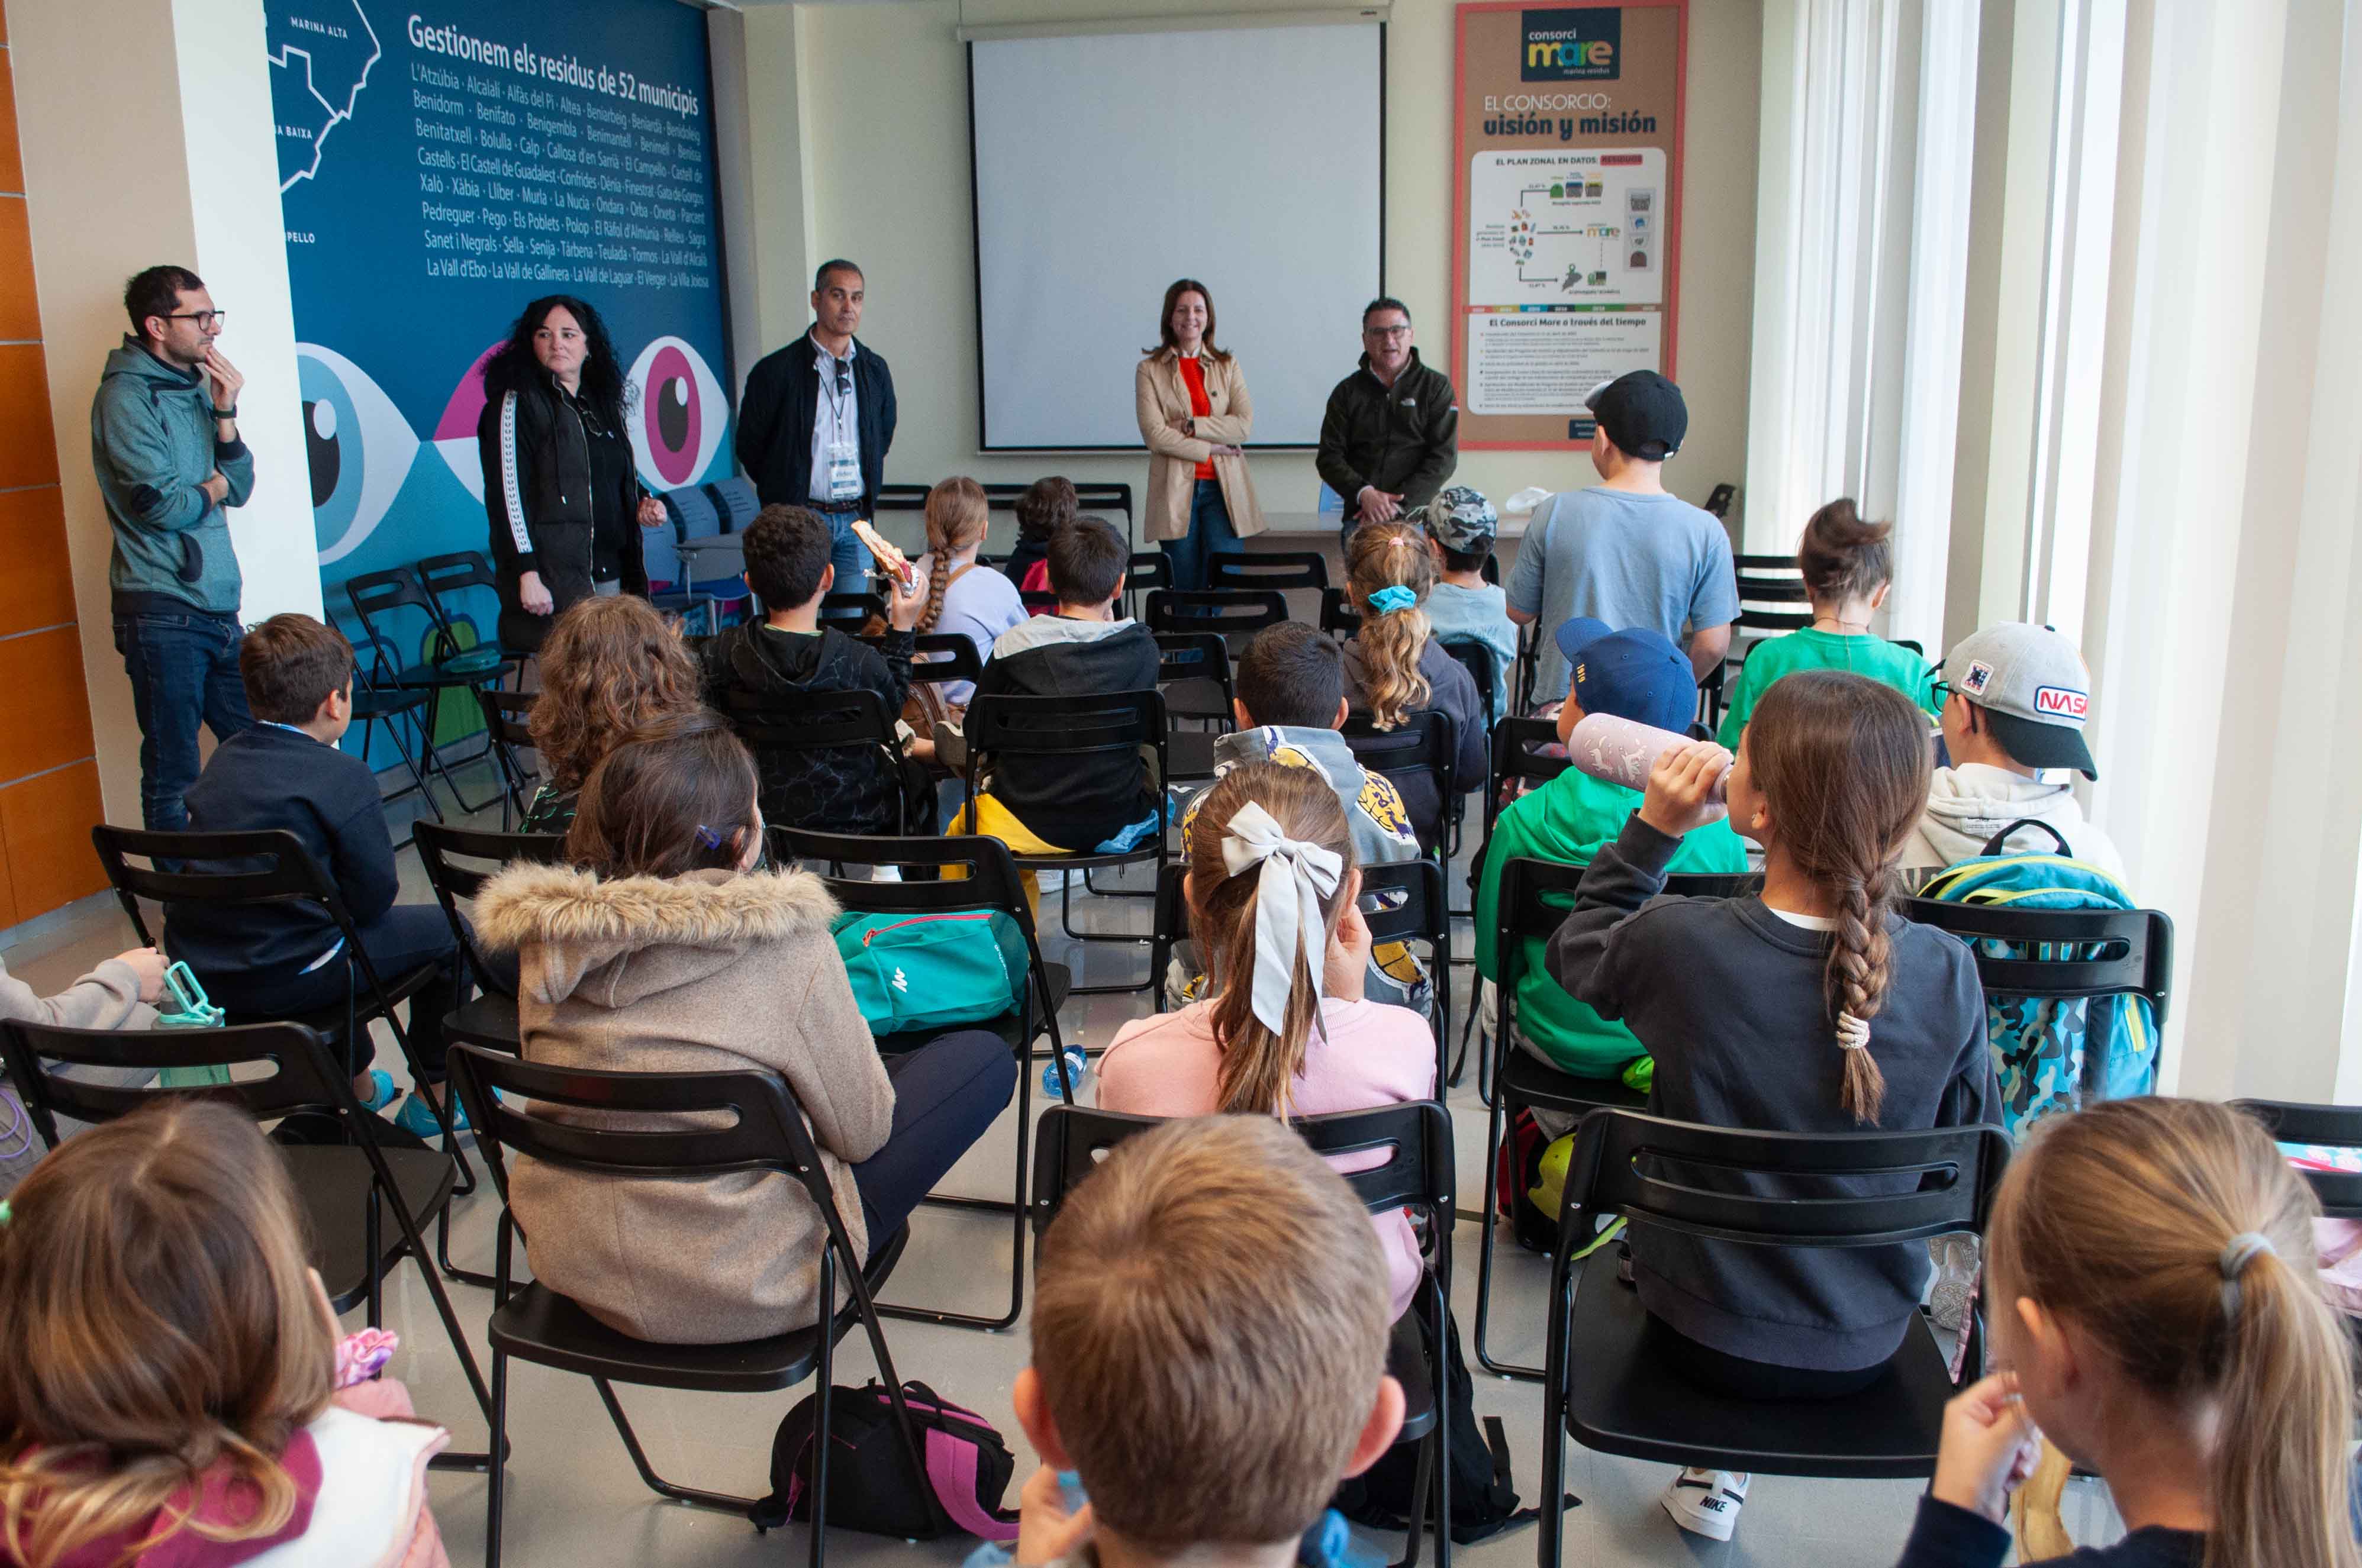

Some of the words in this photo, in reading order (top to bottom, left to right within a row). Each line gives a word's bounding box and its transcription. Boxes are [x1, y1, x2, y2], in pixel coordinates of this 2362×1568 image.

[291, 17, 325, 34] MARINA
[328, 25, 348, 39] ALTA
[1529, 28, 1577, 41] consorci
[408, 14, 510, 69] Gestionem
[514, 44, 537, 76] els
[540, 56, 595, 90] residus
[598, 65, 616, 95] de
[618, 72, 636, 101] 52
[639, 83, 699, 119] municipis
[1528, 41, 1613, 67] mare
[411, 63, 459, 89] L'Atzúbia
[467, 76, 500, 98] Alcalalí
[530, 89, 544, 108] del
[546, 94, 553, 110] Pi
[560, 97, 581, 116] Altea
[587, 103, 627, 130] Beniarbeig
[1484, 95, 1500, 112] EL
[1504, 93, 1612, 112] CONSORCIO:
[286, 126, 312, 140] BAIXA
[414, 90, 463, 116] Benidorm
[477, 103, 515, 126] Benifato
[527, 114, 576, 138] Benigembla
[588, 126, 631, 148] Benimantell
[1559, 117, 1573, 141] y
[1580, 109, 1657, 134] misión
[416, 118, 472, 144] Benitatxell
[481, 130, 511, 151] Bolulla
[520, 137, 540, 161] Calp
[547, 142, 576, 162] Callosa
[578, 147, 596, 164] d'en
[626, 156, 631, 170] El
[634, 158, 666, 179] Campello
[694, 167, 702, 182] de
[418, 147, 455, 169] Castells
[461, 153, 469, 170] El
[471, 155, 500, 175] Castell
[501, 159, 513, 177] de
[515, 162, 556, 183] Guadalest
[560, 169, 596, 189] Confrides
[625, 179, 653, 196] Finestrat
[673, 186, 681, 201] de
[420, 173, 443, 192] Xalò
[453, 177, 479, 196] Xàbia
[523, 187, 546, 204] Murla
[555, 191, 564, 207] La
[597, 197, 623, 214] Ondara
[630, 201, 647, 217] Orba
[681, 208, 704, 224] Parcent
[423, 201, 475, 227] Pedreguer
[483, 208, 506, 231] Pego
[514, 211, 526, 227] Els
[529, 212, 559, 231] Poblets
[566, 217, 589, 238] Polop
[595, 220, 601, 234] El
[425, 230, 453, 248] Sanet
[456, 231, 459, 248] i
[461, 233, 497, 255] Negrals
[502, 235, 523, 253] Sella
[530, 238, 555, 260] Senija
[598, 244, 627, 260] Teulada
[630, 247, 657, 262] Tormos
[662, 250, 669, 263] La
[671, 250, 682, 264] Vall
[427, 258, 439, 275] La
[441, 258, 457, 276] Vall
[460, 259, 486, 277] d'Ebo
[492, 262, 502, 278] La
[504, 262, 520, 279] Vall
[521, 262, 532, 279] de
[534, 263, 569, 280] Gallinera
[574, 267, 582, 281] La
[584, 266, 598, 282] Vall
[599, 267, 608, 282] de
[610, 269, 633, 288] Laguar
[637, 269, 643, 284] El
[645, 271, 666, 289] Verger
[670, 272, 677, 286] La
[1490, 318, 1498, 327] El
[1500, 318, 1537, 327] Consorci
[1539, 318, 1560, 327] Mare
[1600, 317, 1614, 325] del
[1616, 317, 1646, 328] tiempo
[1577, 663, 1586, 683] 1919
[1699, 1495, 1728, 1513] NIKE
